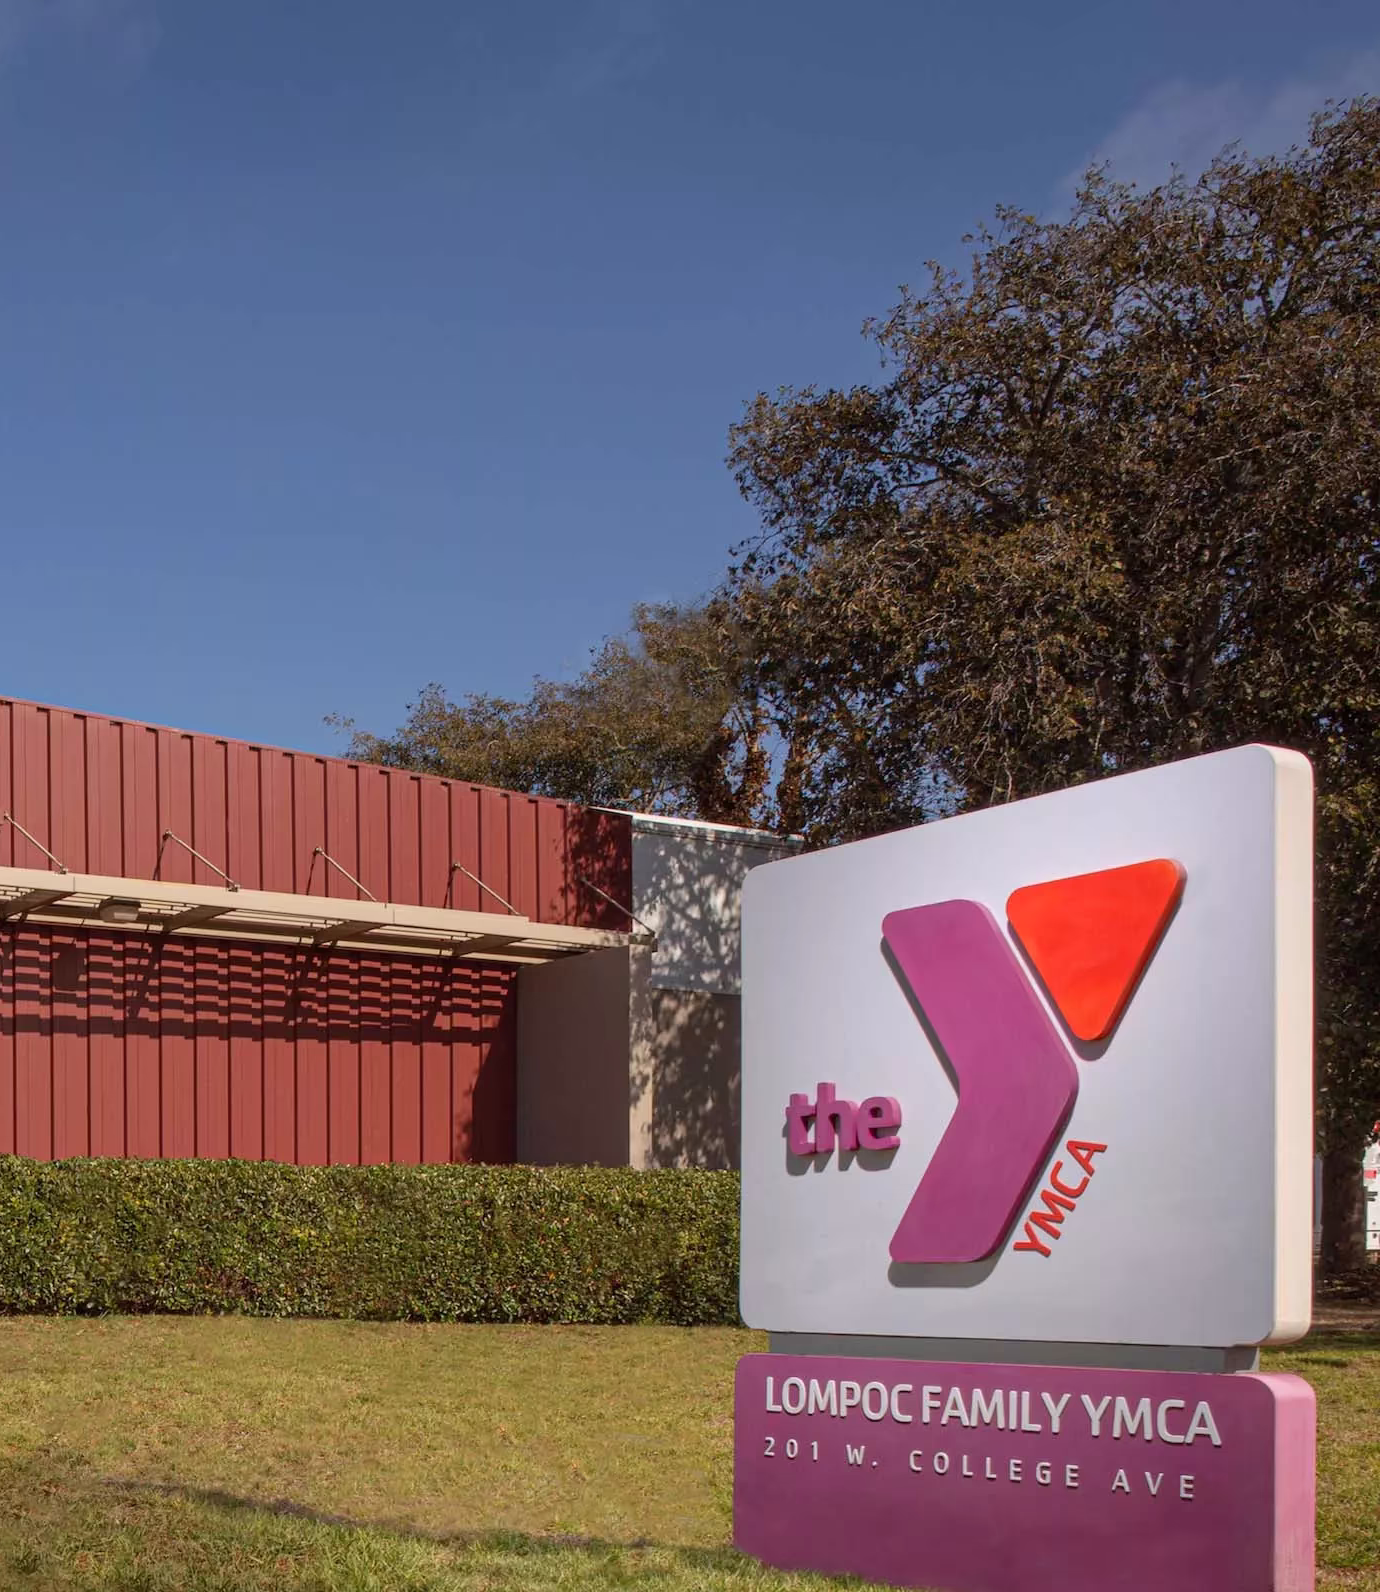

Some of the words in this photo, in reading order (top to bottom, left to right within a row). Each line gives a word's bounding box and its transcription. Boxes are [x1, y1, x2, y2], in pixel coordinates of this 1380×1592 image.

[785, 1082, 902, 1155] the
[1013, 1139, 1108, 1258] YMCA
[765, 1376, 913, 1423] LOMPOC
[922, 1385, 1071, 1434] FAMILY
[1080, 1394, 1222, 1447] YMCA
[763, 1436, 819, 1462] 201
[845, 1443, 879, 1468] W.
[909, 1450, 1079, 1488] COLLEGE
[1111, 1468, 1195, 1500] AVE
